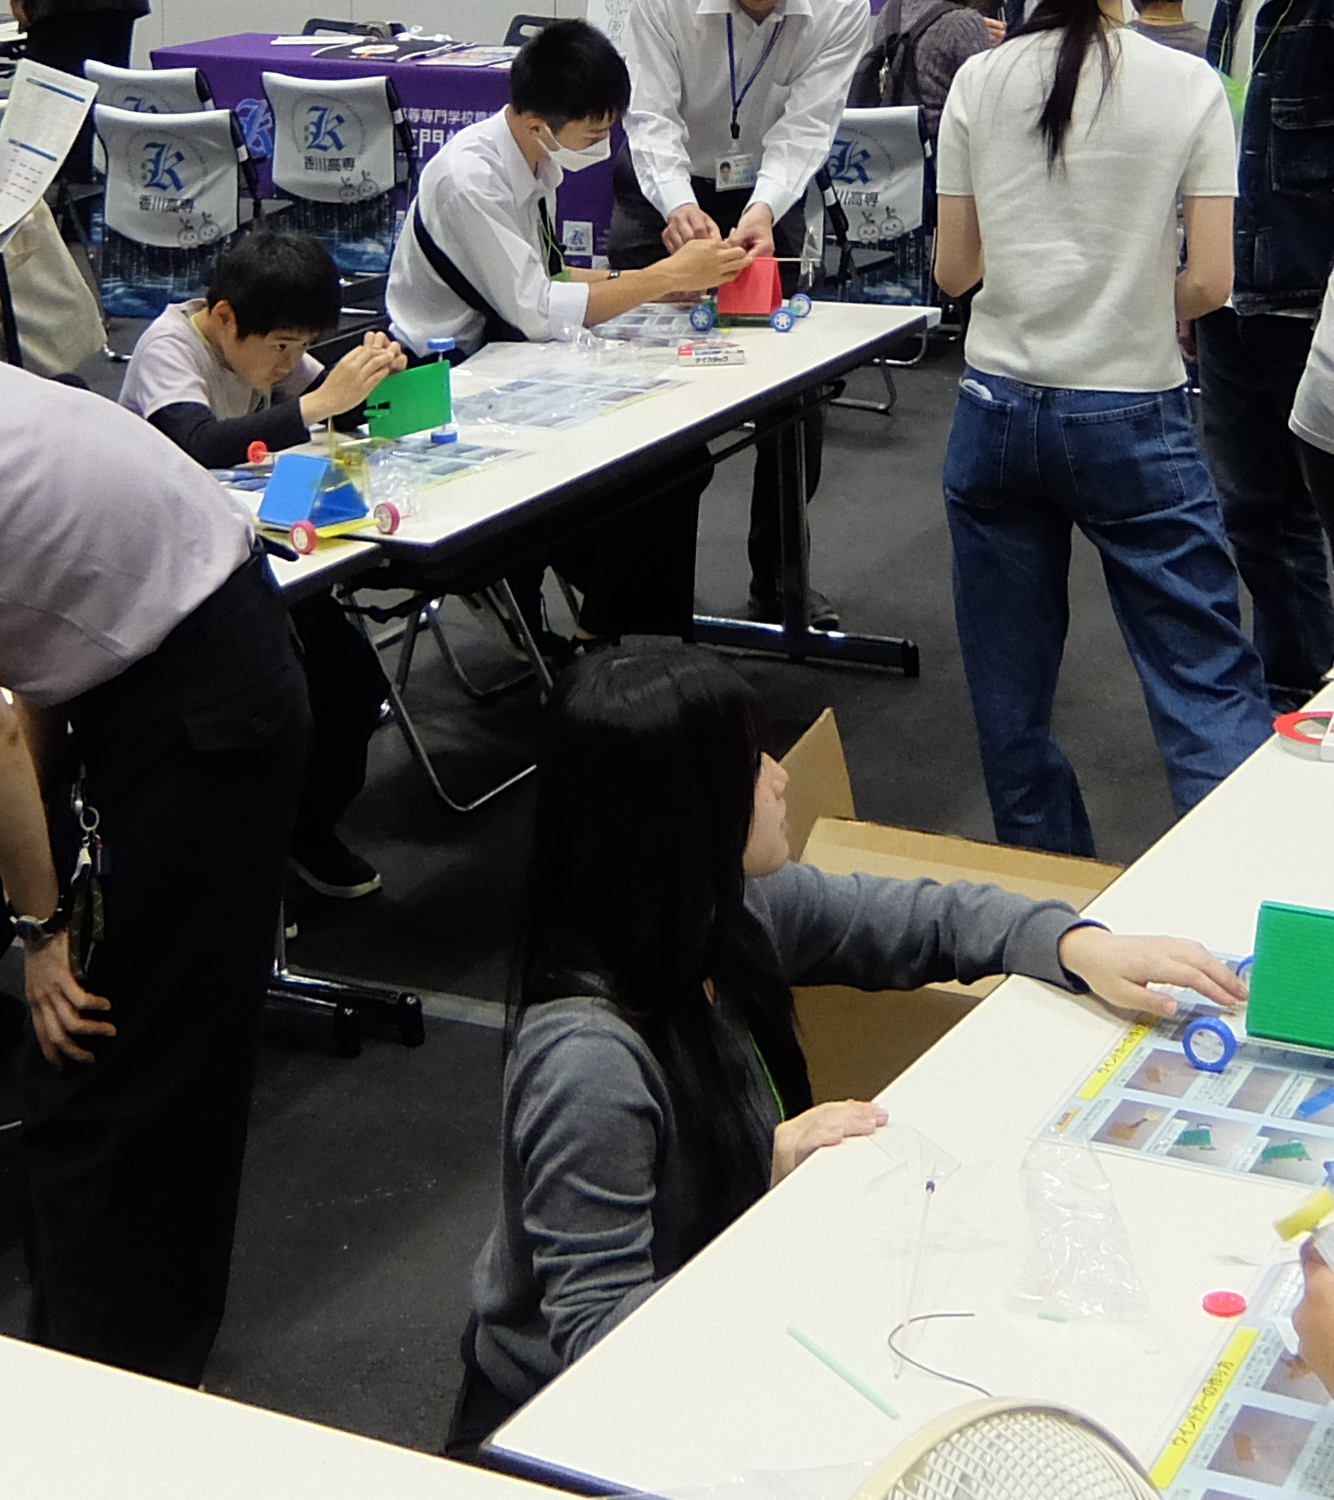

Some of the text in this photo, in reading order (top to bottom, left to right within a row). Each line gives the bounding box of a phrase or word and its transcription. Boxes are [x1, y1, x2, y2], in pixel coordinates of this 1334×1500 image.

[304, 156, 355, 172] 香川高専
[139, 194, 196, 213] 香川高専
